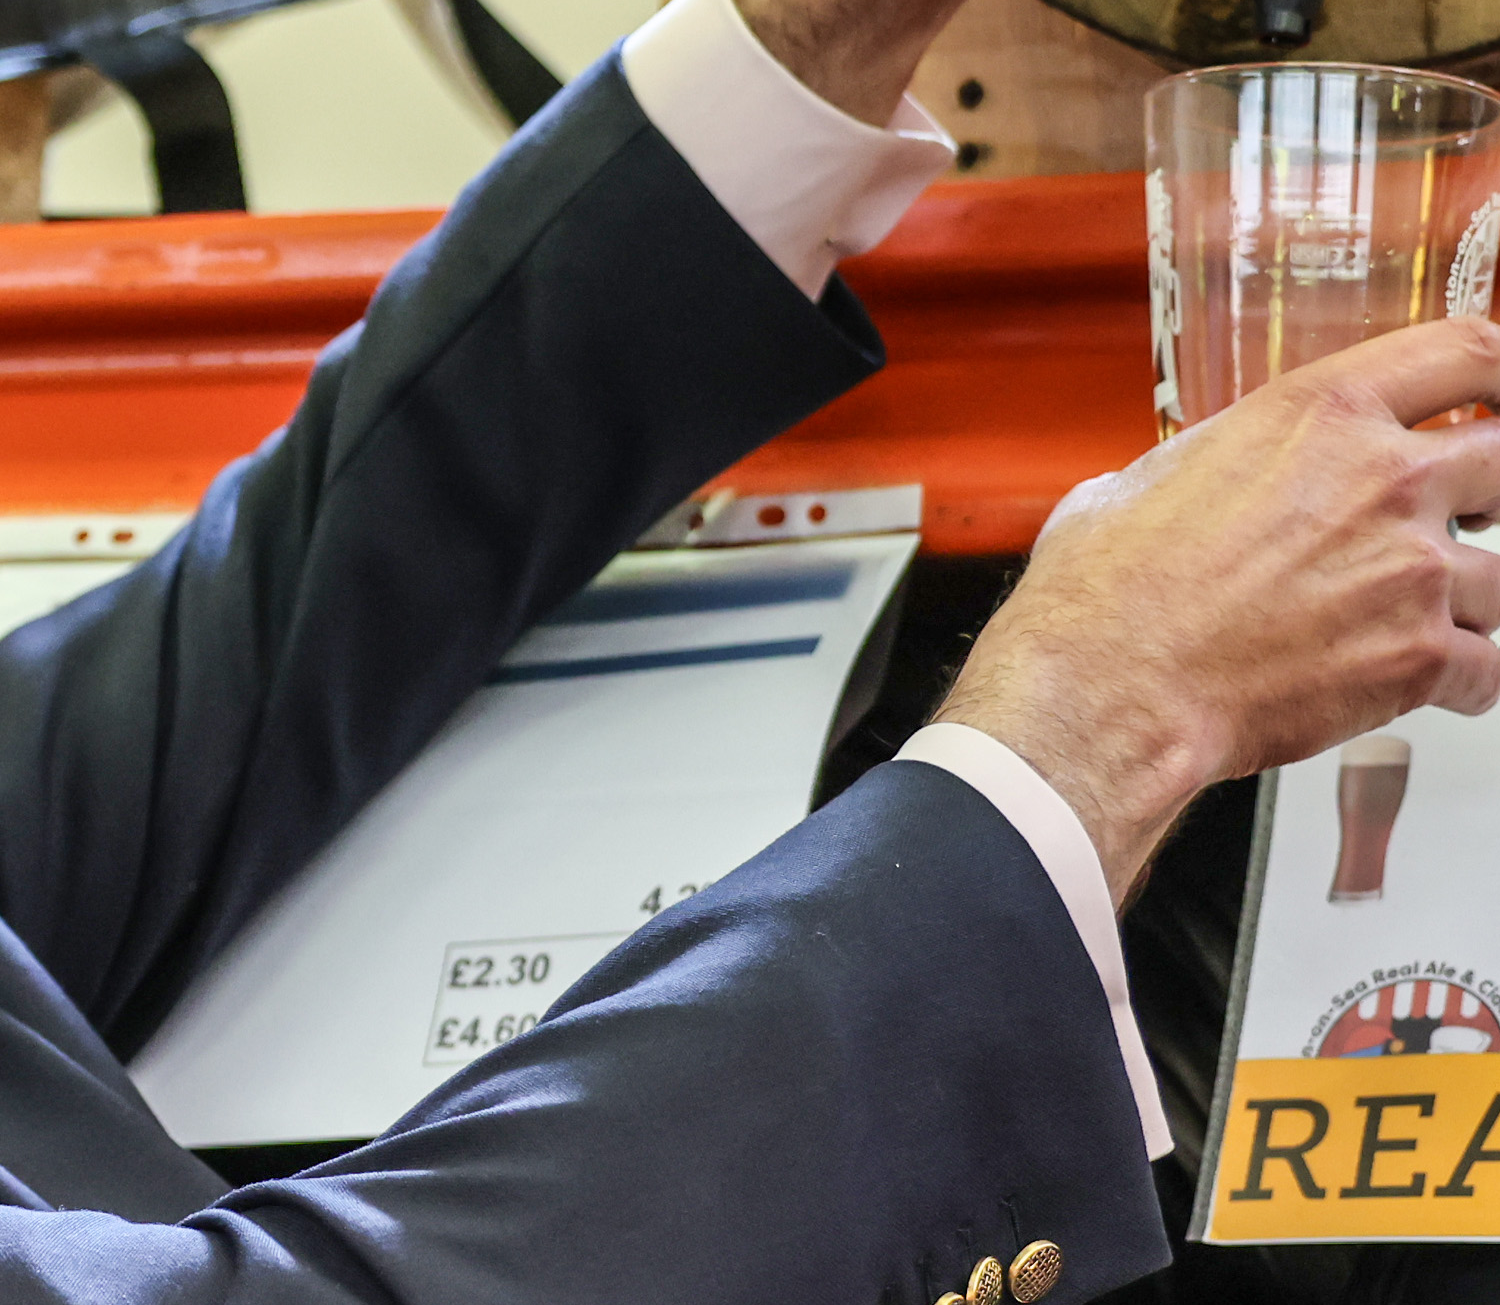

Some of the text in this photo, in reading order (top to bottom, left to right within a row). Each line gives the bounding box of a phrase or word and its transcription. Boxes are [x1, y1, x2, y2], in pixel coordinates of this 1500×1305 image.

[448, 952, 551, 989] £2.30
[1301, 980, 1369, 1058] n-on-Sea
[1371, 961, 1419, 985] Real
[1424, 960, 1457, 978] Ale
[1460, 969, 1476, 986] &
